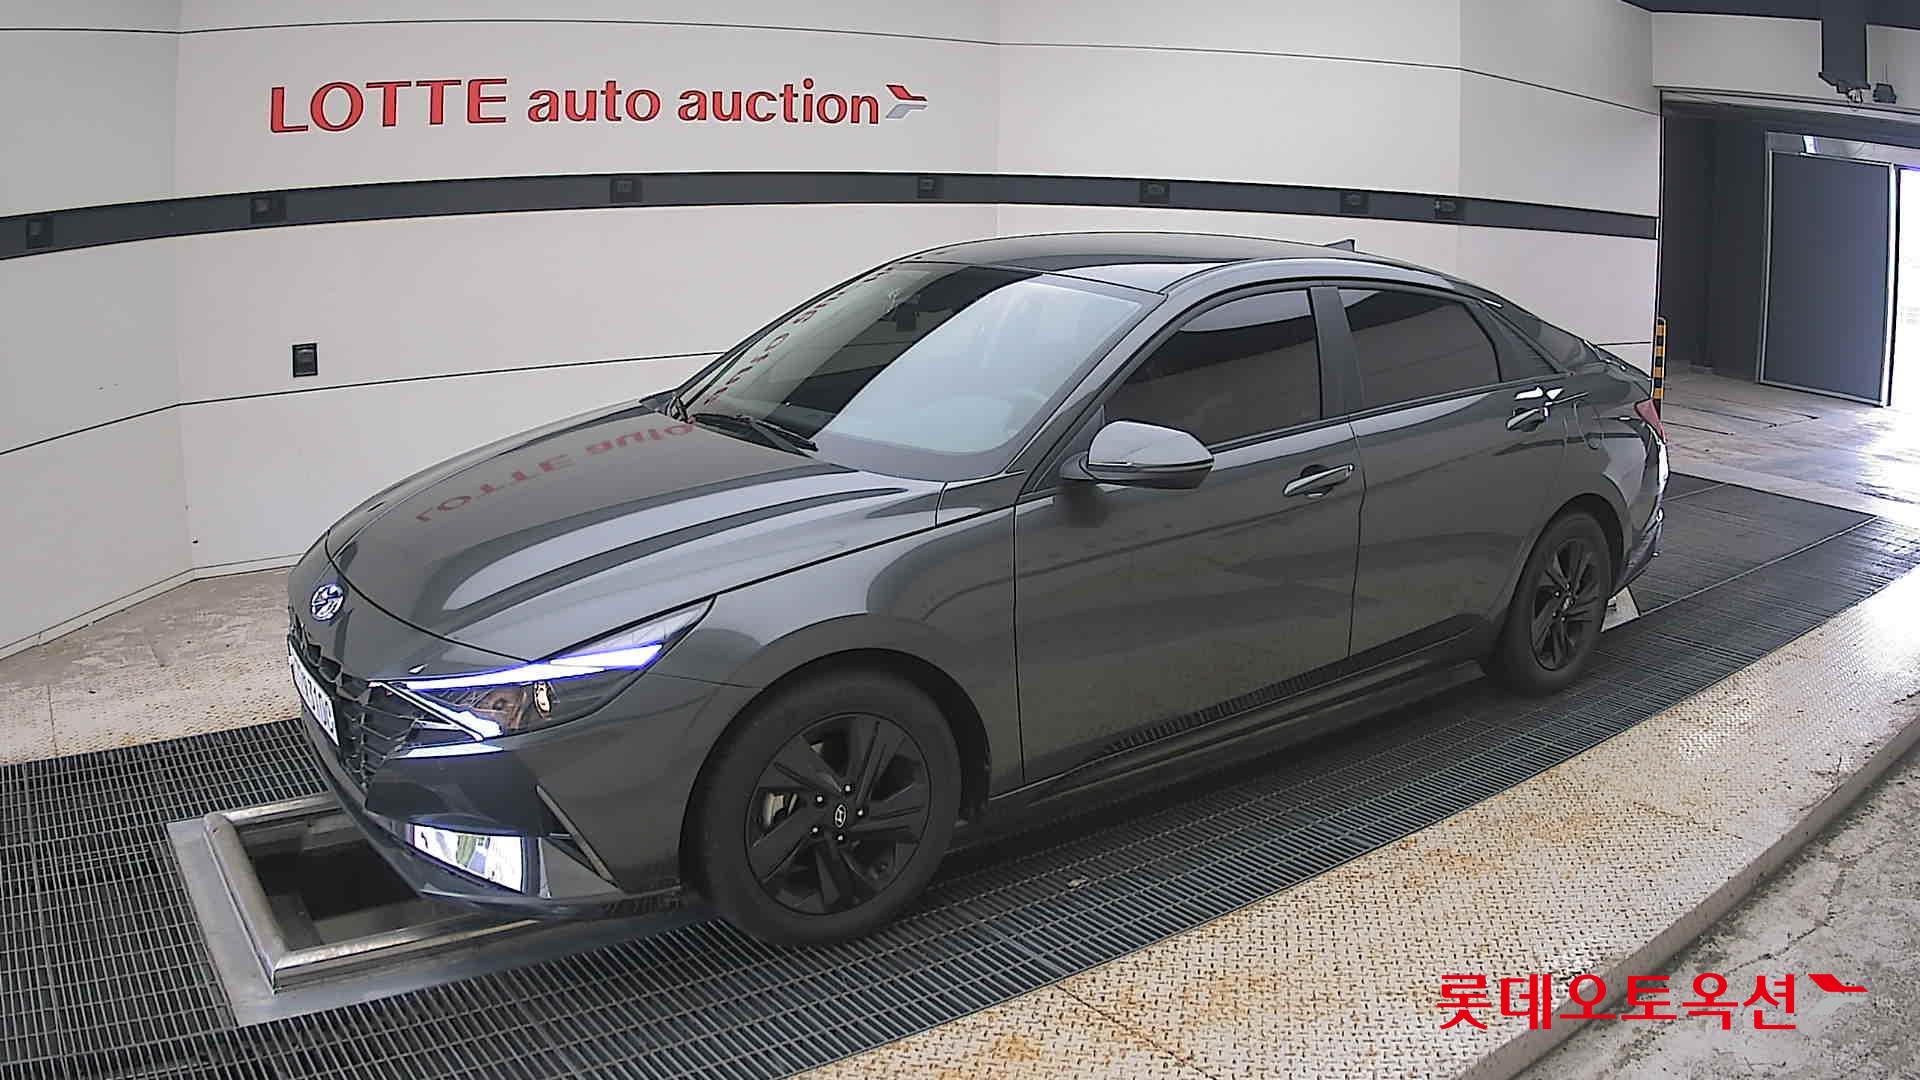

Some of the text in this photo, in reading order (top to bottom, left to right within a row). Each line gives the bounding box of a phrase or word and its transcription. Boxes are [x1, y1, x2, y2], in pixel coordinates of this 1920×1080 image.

[270, 78, 880, 133] LOTTE auto auction
